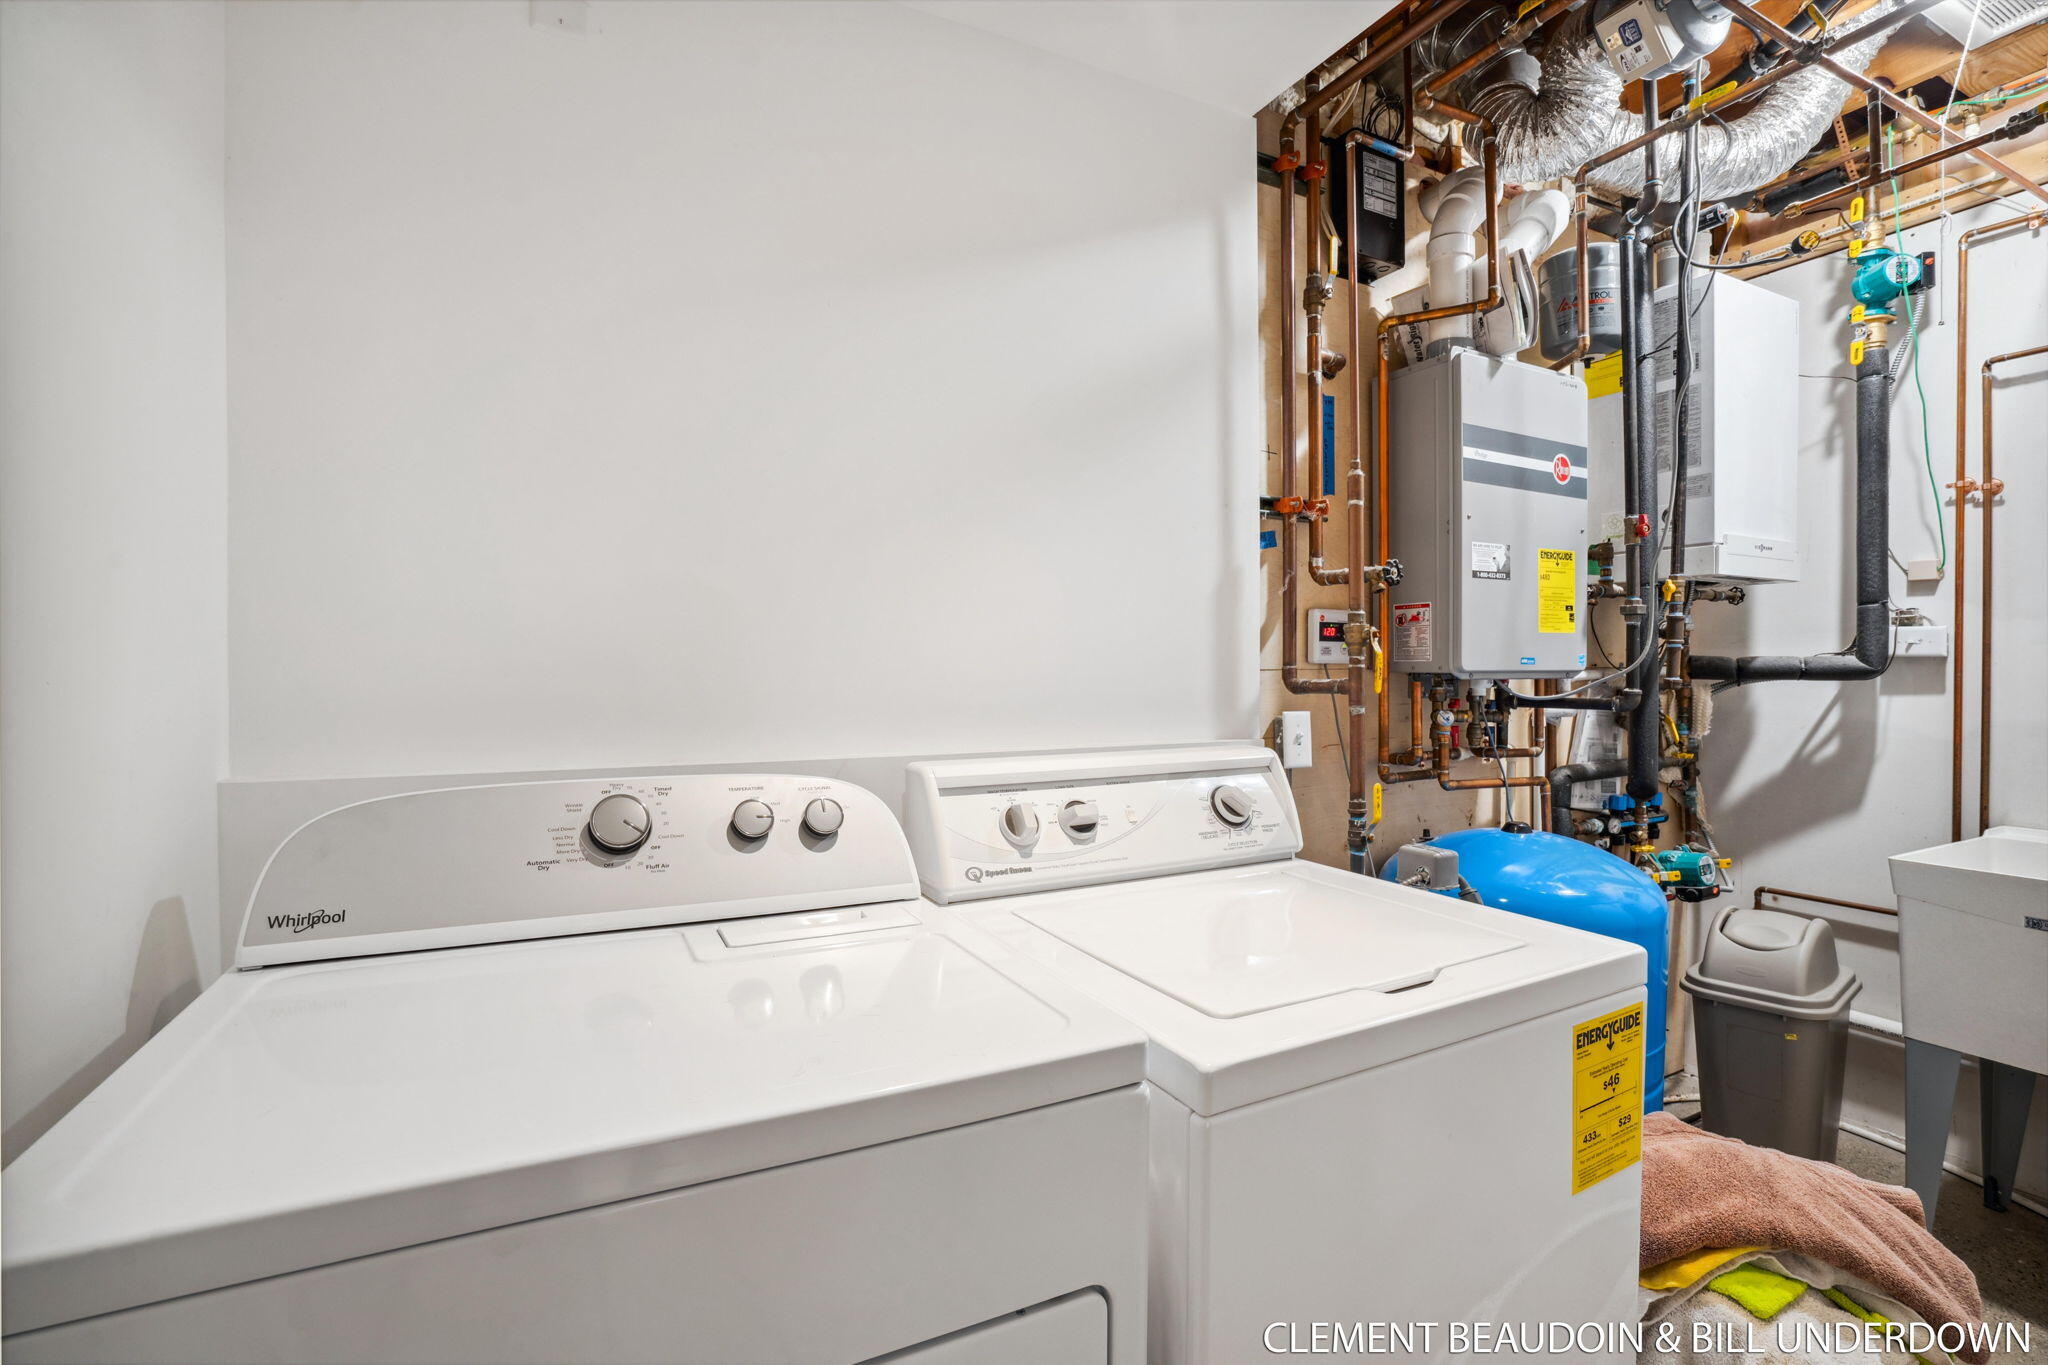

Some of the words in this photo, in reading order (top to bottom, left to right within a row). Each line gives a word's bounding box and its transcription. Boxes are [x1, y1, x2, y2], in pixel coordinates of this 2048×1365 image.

[1540, 551, 1573, 561] ENERGYGUIDE
[1322, 627, 1336, 637] 120
[526, 859, 561, 867] Automatic
[985, 868, 1009, 878] Speed
[267, 909, 346, 933] Whirlpool
[1576, 1011, 1641, 1050] ENERGYGUIDE
[1603, 1073, 1620, 1091] $46
[1618, 1114, 1632, 1128] $29
[1582, 1131, 1597, 1144] 433
